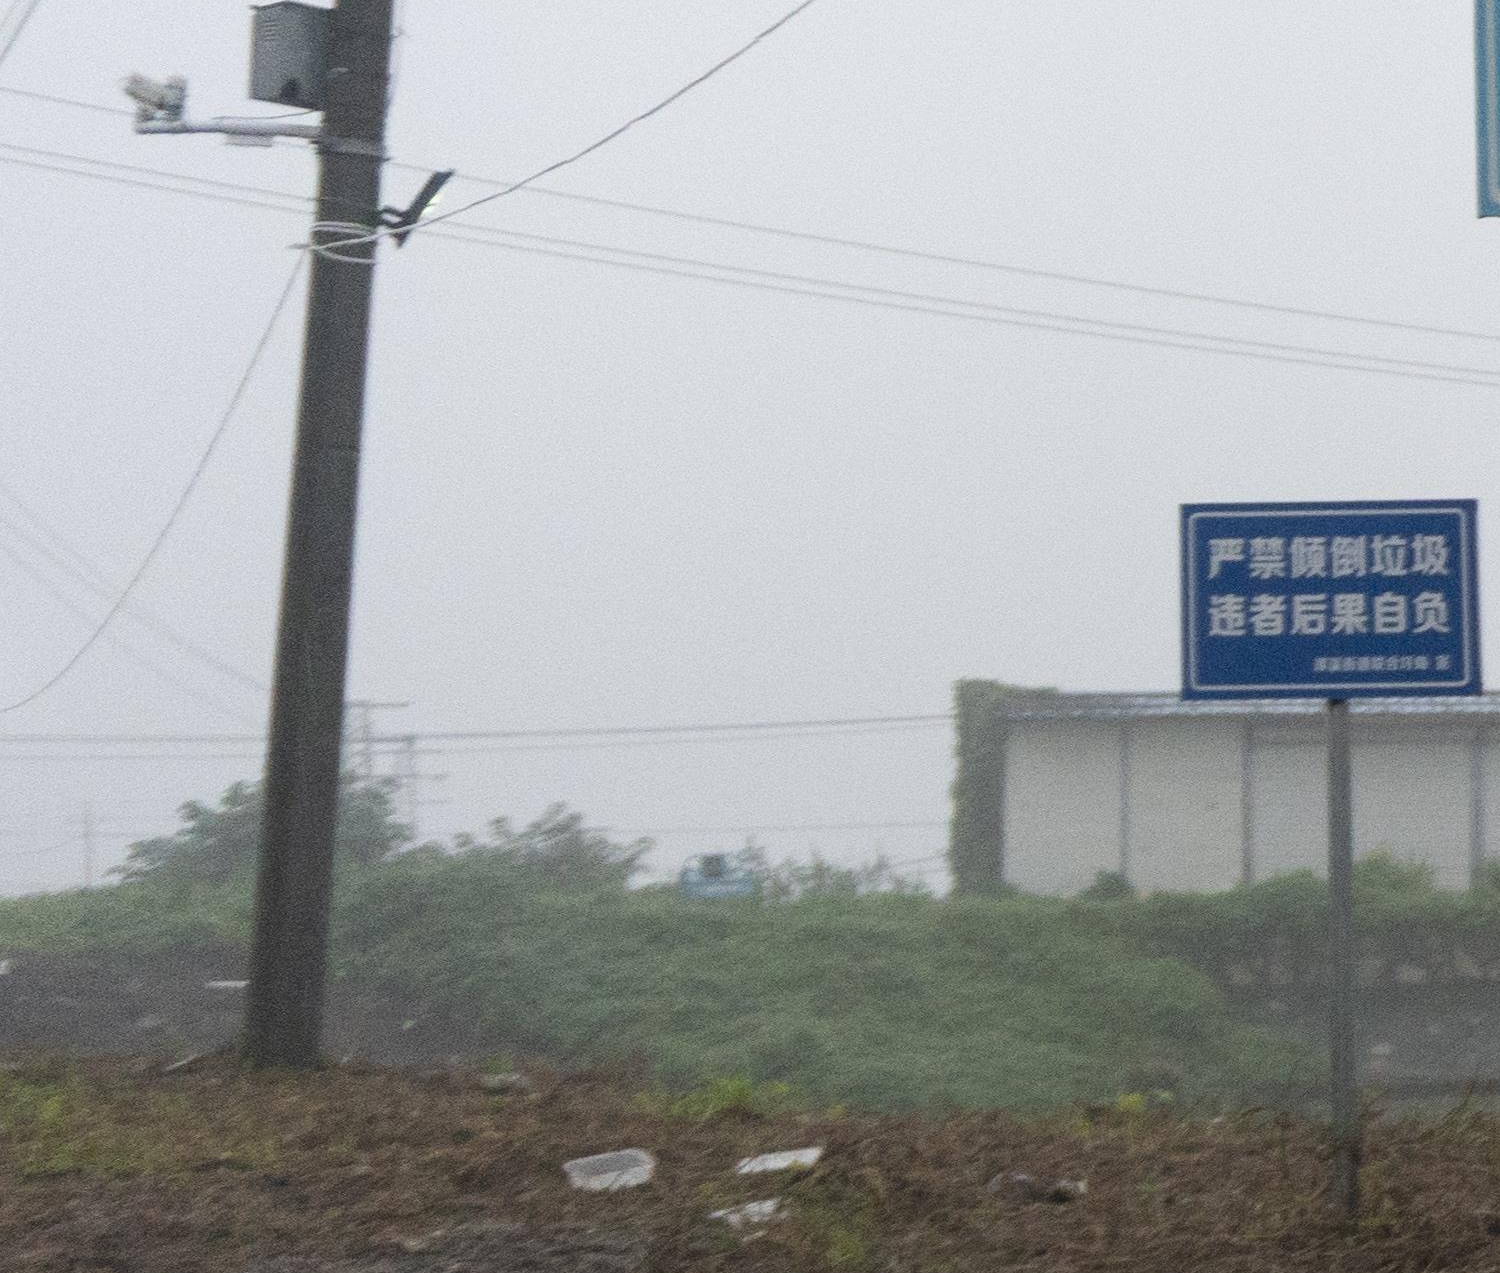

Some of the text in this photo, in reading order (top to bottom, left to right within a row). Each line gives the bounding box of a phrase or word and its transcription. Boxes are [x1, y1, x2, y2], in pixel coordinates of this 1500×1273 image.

[1207, 534, 1450, 580] 严禁倾倒垃圾
[1208, 591, 1451, 638] 违者后果自负
